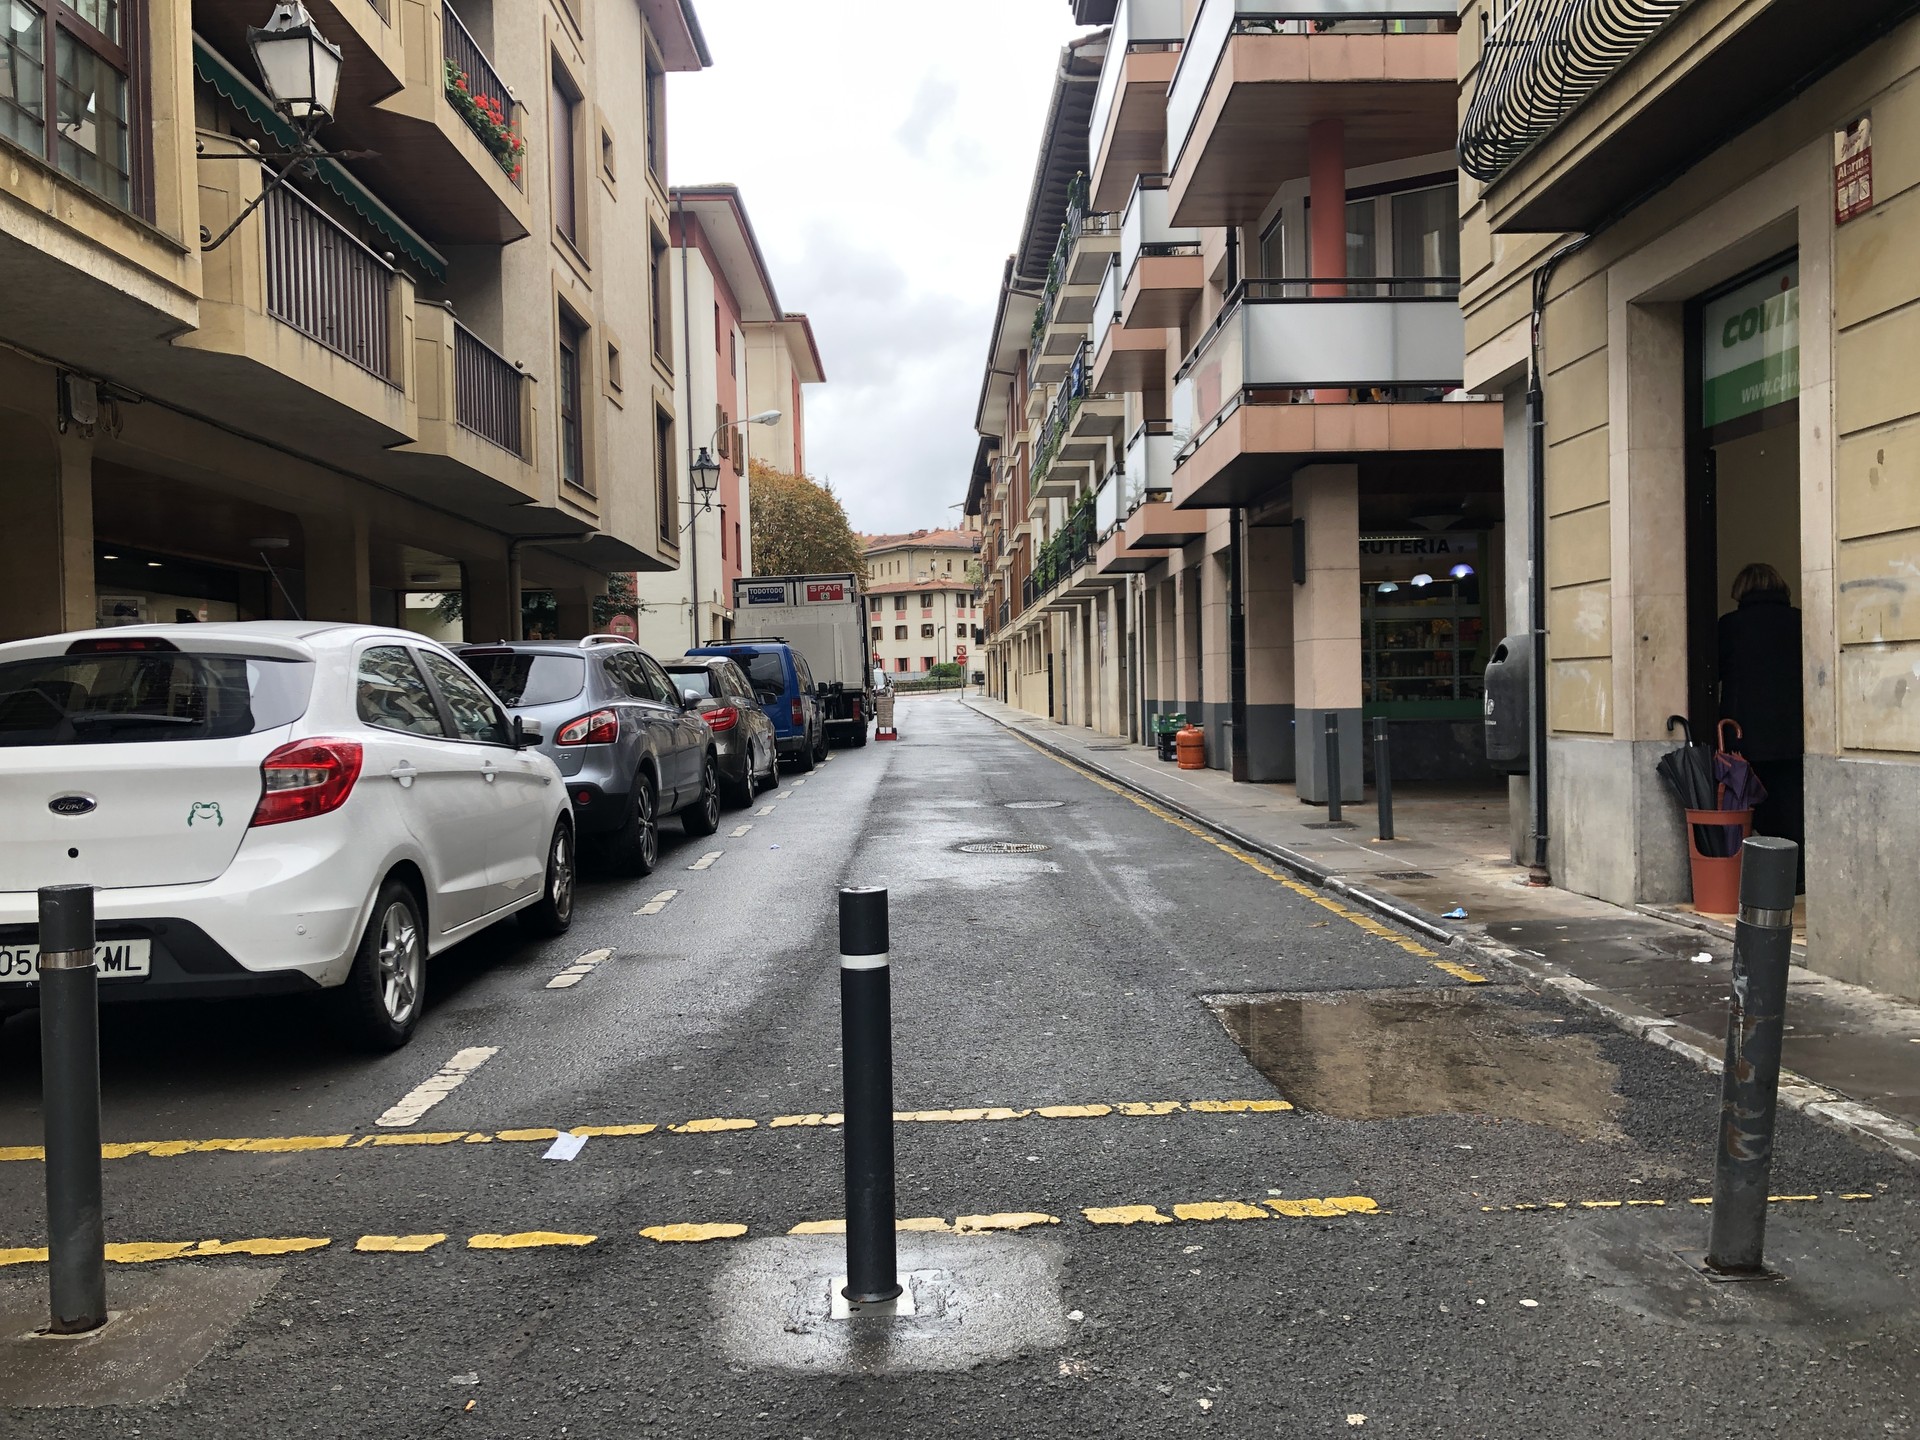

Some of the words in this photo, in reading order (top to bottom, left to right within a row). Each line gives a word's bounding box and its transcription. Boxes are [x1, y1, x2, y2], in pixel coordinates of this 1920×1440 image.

[1838, 155, 1870, 181] Alarma
[809, 584, 841, 592] SPAR
[57, 801, 85, 811] Ford
